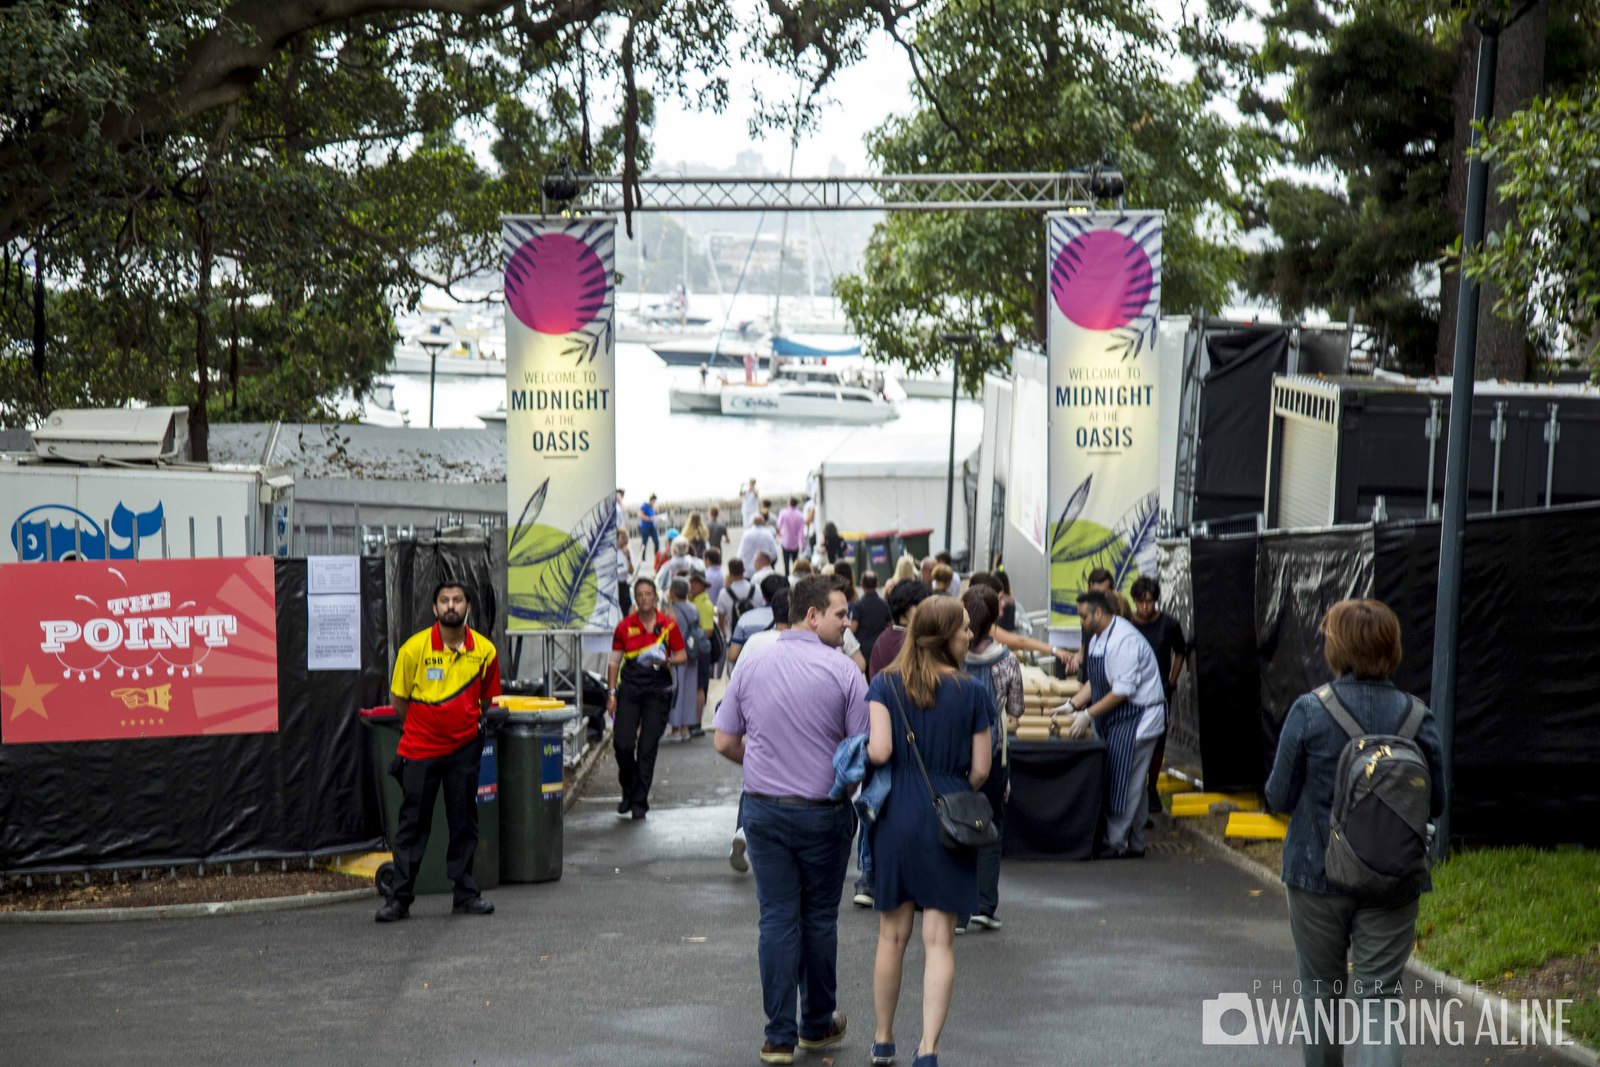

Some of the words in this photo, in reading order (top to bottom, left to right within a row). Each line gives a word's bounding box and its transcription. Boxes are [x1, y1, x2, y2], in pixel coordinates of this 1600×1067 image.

[524, 371, 577, 384] WELCOME
[584, 371, 597, 384] TO
[1069, 367, 1120, 380] WELCOME
[1128, 367, 1141, 379] TO
[512, 389, 610, 411] MIDNIGHT
[1056, 385, 1154, 407] MIDNIGHT
[544, 414, 555, 426] AT
[559, 414, 575, 426] THE
[1089, 410, 1098, 421] AT
[1103, 410, 1117, 421] THE
[532, 430, 590, 452] OASIS
[1076, 426, 1133, 448] OASIS
[107, 591, 171, 616] THE
[39, 615, 237, 654] POINT
